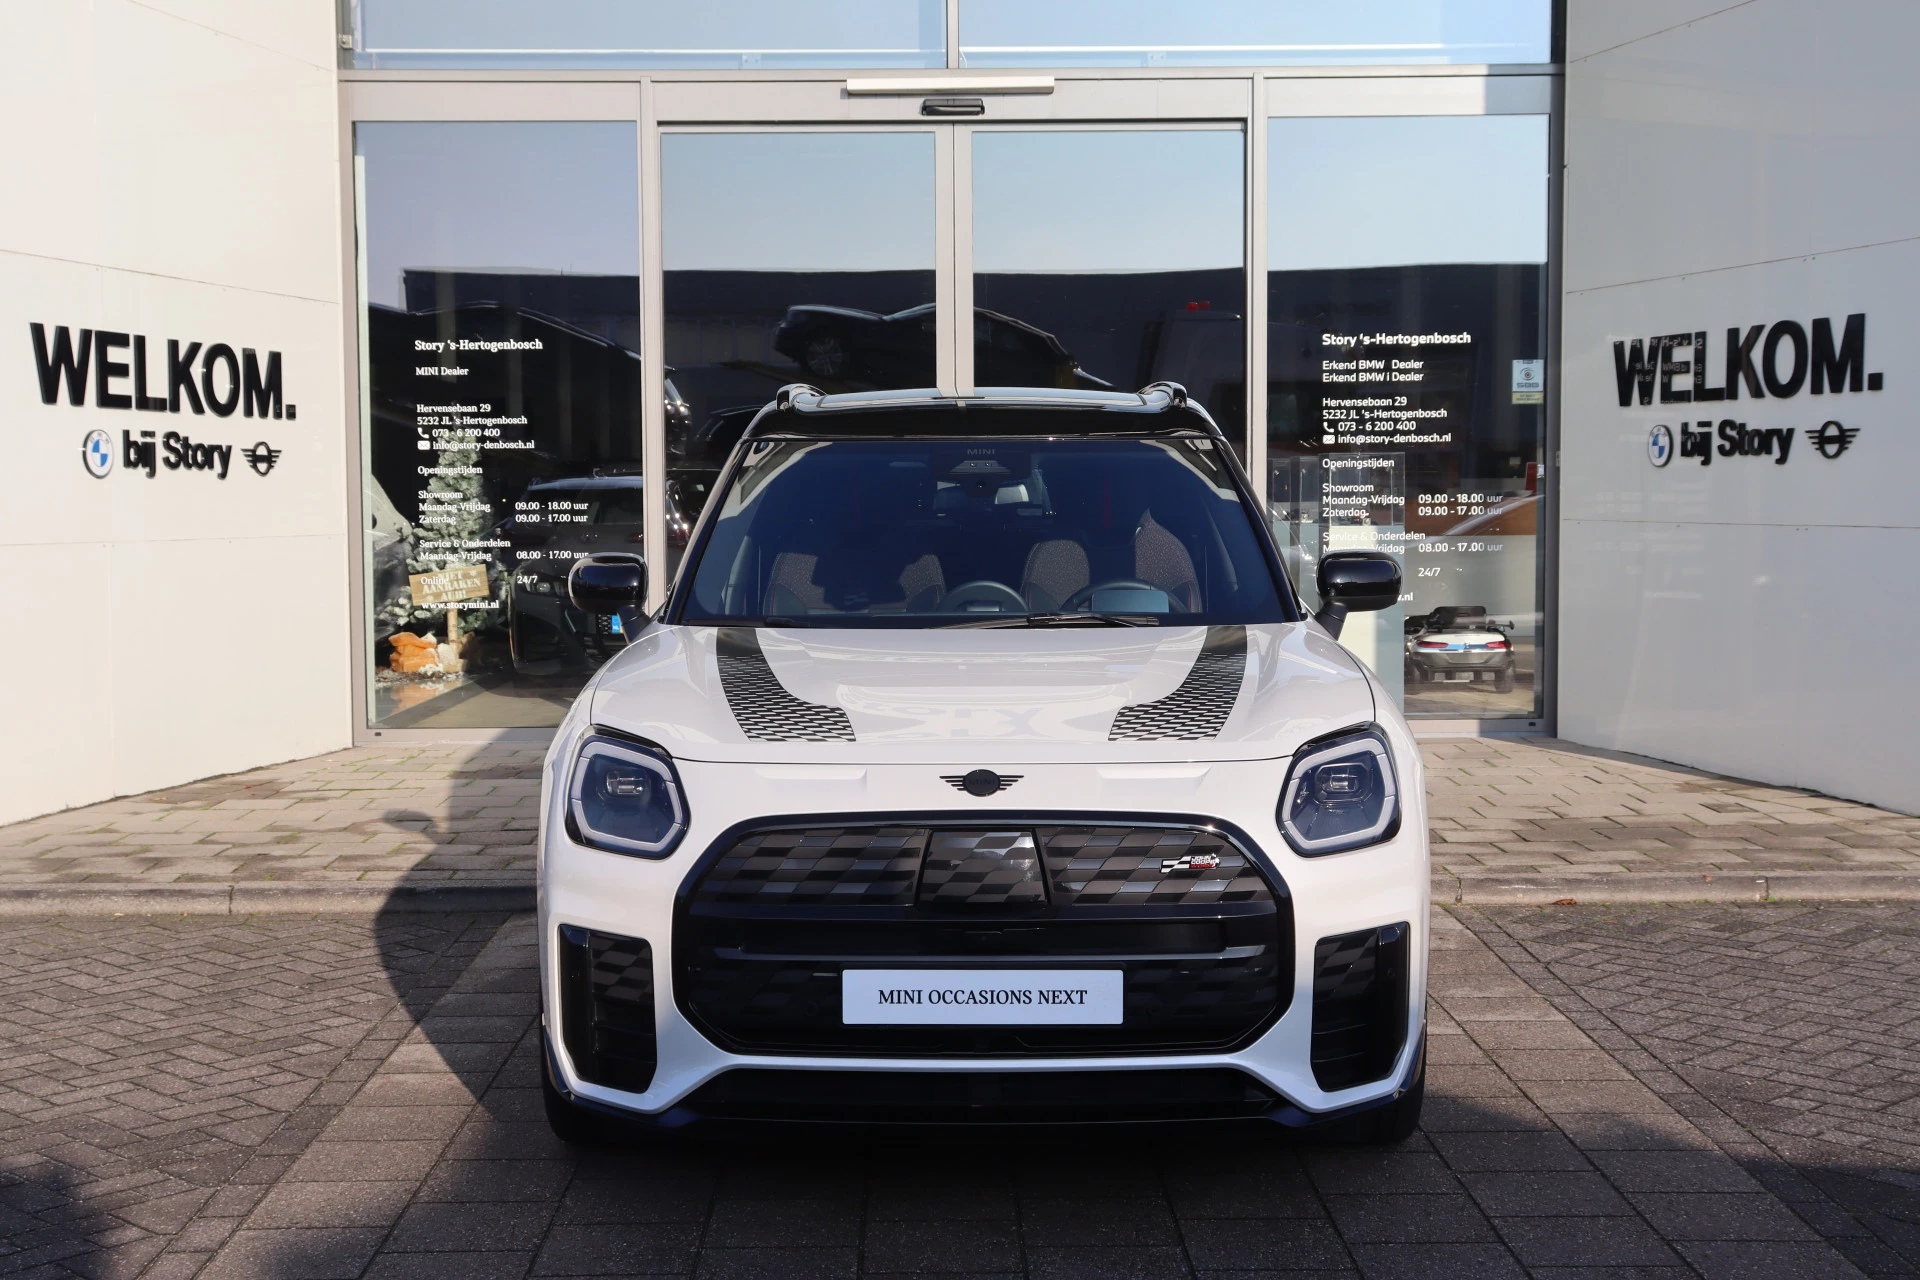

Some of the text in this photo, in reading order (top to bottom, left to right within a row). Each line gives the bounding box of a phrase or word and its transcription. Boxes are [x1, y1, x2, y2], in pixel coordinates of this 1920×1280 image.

[1322, 333, 1357, 347] Story
[415, 340, 445, 353] Story
[1322, 359, 1424, 370] Erkend BMW Dealer
[1613, 313, 1884, 407] WELKOM.
[29, 321, 297, 420] WELKOM.
[415, 366, 469, 376] MINI Dealer
[1322, 373, 1357, 382] Erkend
[1358, 372, 1385, 382] BMW
[1391, 371, 1424, 382] Dealer
[1322, 396, 1408, 407] Hervensebaan 29
[416, 403, 491, 413] Hervensebaan 29
[416, 416, 439, 425] 5232
[440, 416, 452, 425] JL
[1322, 410, 1347, 419] 5232
[1348, 410, 1360, 420] JL
[1338, 422, 1357, 432] 073
[1365, 422, 1373, 431] 6
[1374, 421, 1394, 431] 200
[1396, 421, 1417, 431] 400
[431, 429, 450, 438] 073
[456, 428, 463, 437] 6
[464, 428, 482, 437] 200
[483, 428, 500, 437] 400
[1337, 433, 1452, 444] info@story-denbosch.nl
[432, 440, 535, 450] info@story-denbosch.nl
[1680, 418, 1796, 466] bij Story
[122, 429, 232, 480] bij Story
[1322, 458, 1395, 470] Openingstijden
[417, 466, 483, 476] Openingstijden
[1322, 482, 1375, 492] Showroom
[418, 490, 463, 499] Showroom
[1322, 494, 1405, 505] Maandag-Vrijdag
[1418, 494, 1448, 504] 09.00
[1456, 494, 1485, 503] 18.00
[1486, 495, 1504, 503] uur
[418, 502, 491, 513] Maandag-Vrijdag
[515, 502, 540, 511] 09.00
[547, 502, 572, 510] 18.00
[573, 502, 589, 510] uur
[1322, 508, 1367, 518] Zaterdag
[1418, 506, 1448, 516] 09.00
[1487, 507, 1503, 515] uur
[418, 515, 456, 525] Zaterdag
[515, 514, 540, 523] 09.00
[547, 514, 572, 522] 17.00
[573, 514, 589, 522] uur
[1322, 530, 1426, 541] Service & Onderdelen
[419, 539, 511, 548] Service & Onderdelen
[1418, 543, 1448, 552] 08.00
[1487, 543, 1504, 552] uur
[420, 551, 492, 561] Maandag-Vrijdag
[516, 551, 541, 560] 08.00
[548, 551, 573, 559] 17.00
[1418, 568, 1441, 577] 24/7
[516, 575, 538, 584] 24/7
[420, 600, 499, 610] www.storymini.nl
[878, 989, 1088, 1005] MINI OCCASIONS NEXT
